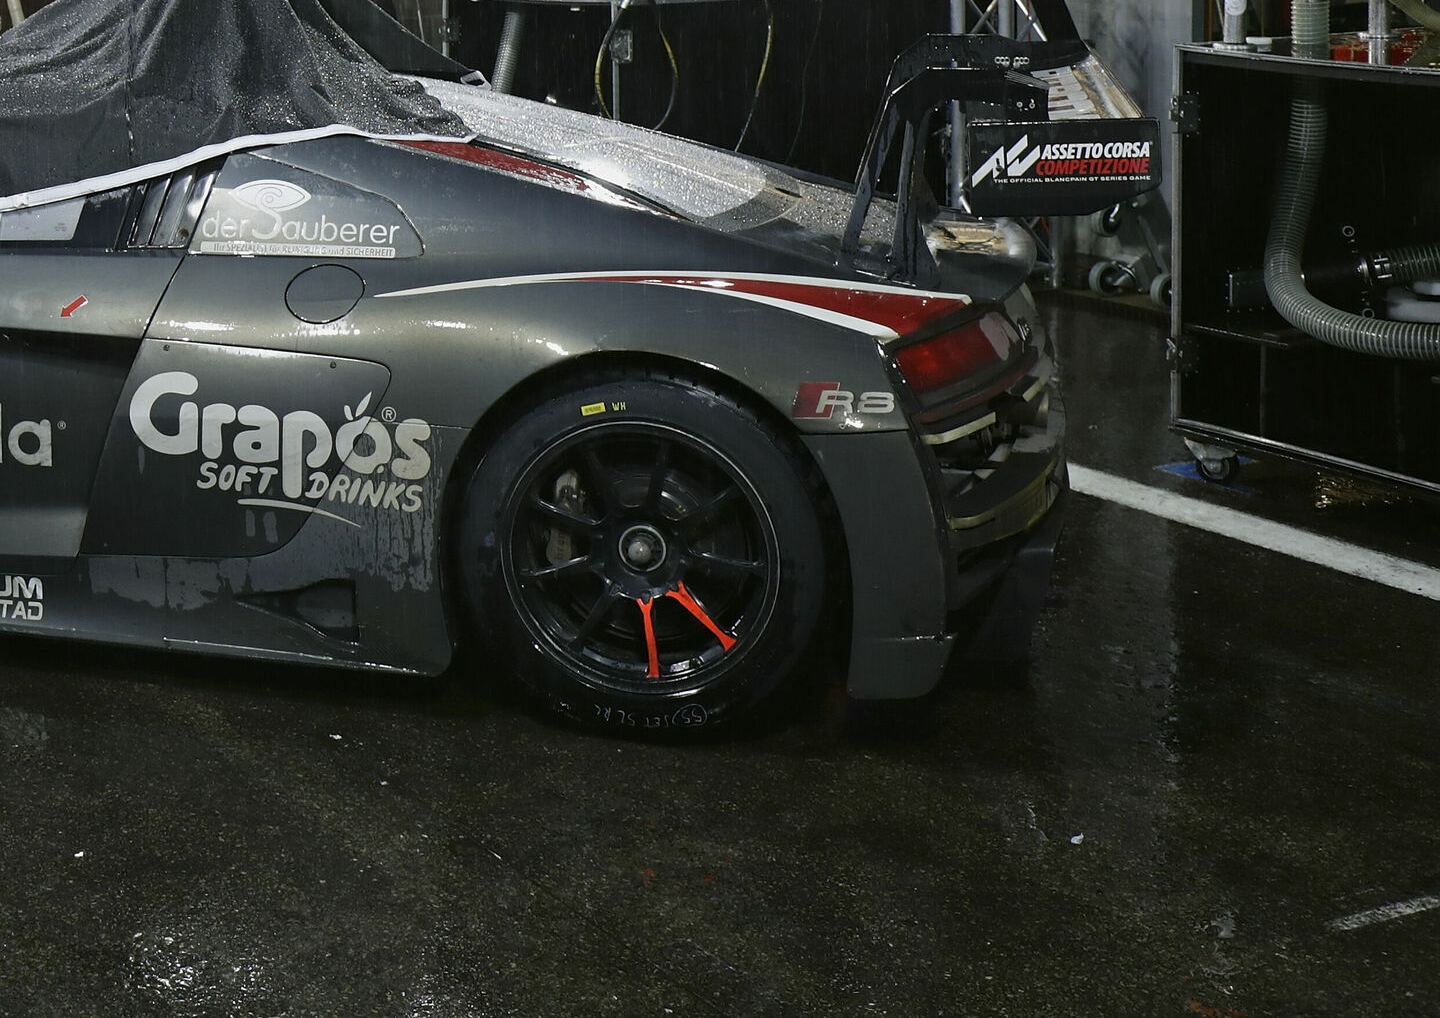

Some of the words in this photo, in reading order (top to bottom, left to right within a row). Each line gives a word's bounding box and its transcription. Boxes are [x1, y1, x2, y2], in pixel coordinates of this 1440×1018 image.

[1041, 144, 1104, 160] ASSETTO
[1104, 142, 1150, 159] CORSA
[1036, 158, 1150, 176] COMPETIZIONE
[202, 210, 247, 238] der
[346, 247, 393, 257] SICHERHEIT
[611, 402, 627, 411] WH
[815, 389, 895, 414] R8
[129, 371, 432, 499] Grapos
[196, 461, 278, 494] SOFT
[305, 471, 423, 513] DRINKS
